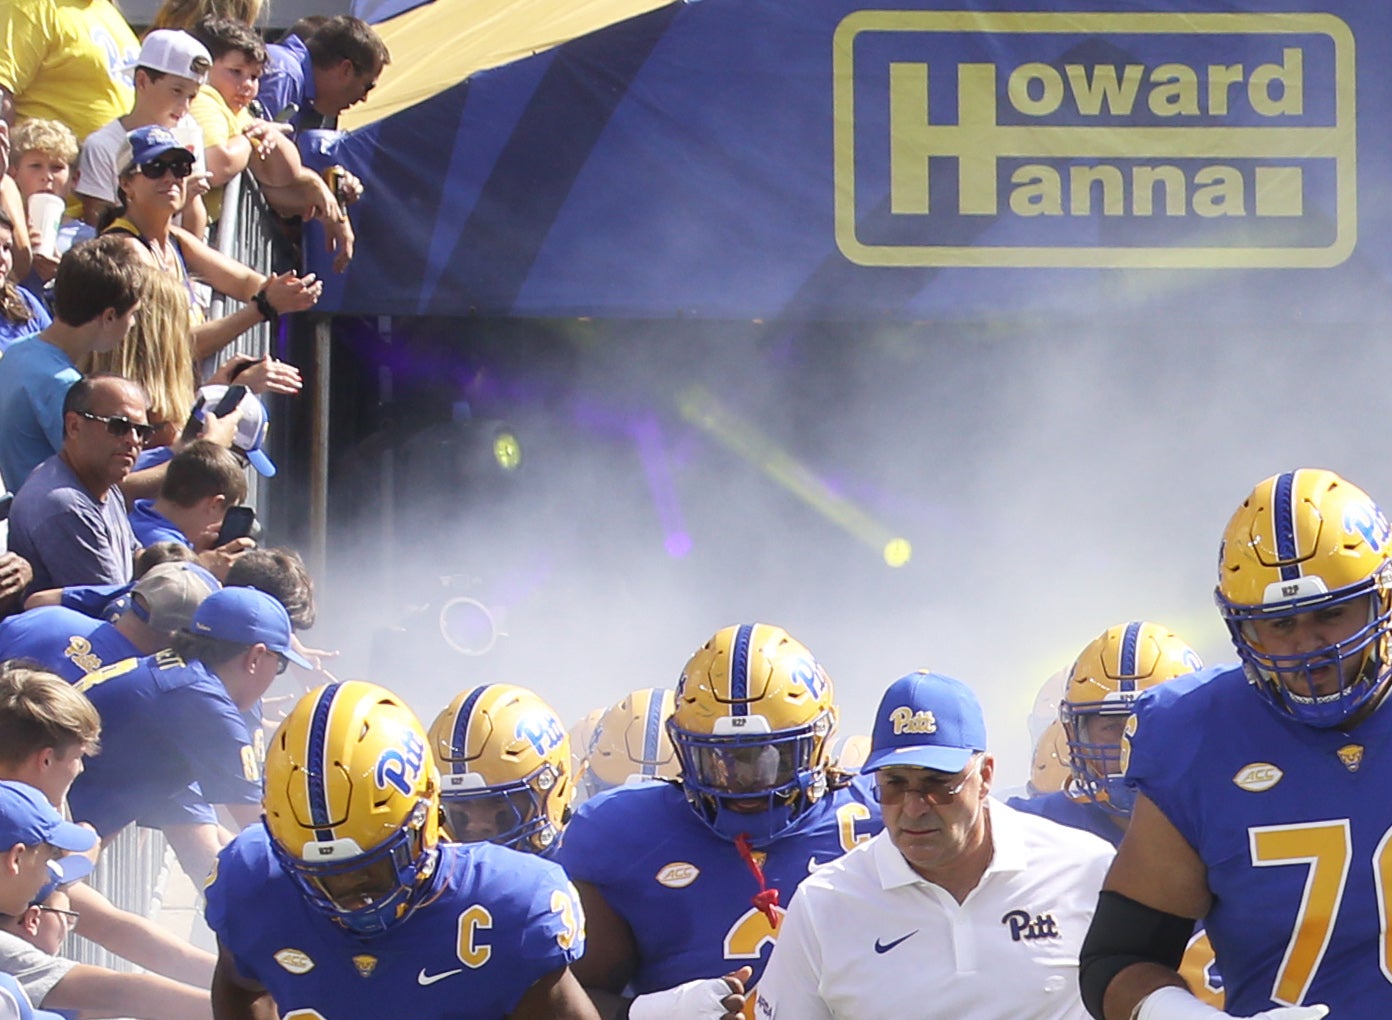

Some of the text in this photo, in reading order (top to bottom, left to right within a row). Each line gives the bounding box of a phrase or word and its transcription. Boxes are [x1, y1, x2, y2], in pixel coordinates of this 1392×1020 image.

[889, 706, 937, 736] Pitt
[836, 803, 871, 852] C
[457, 904, 493, 970] C
[1003, 909, 1061, 942] Pitt
